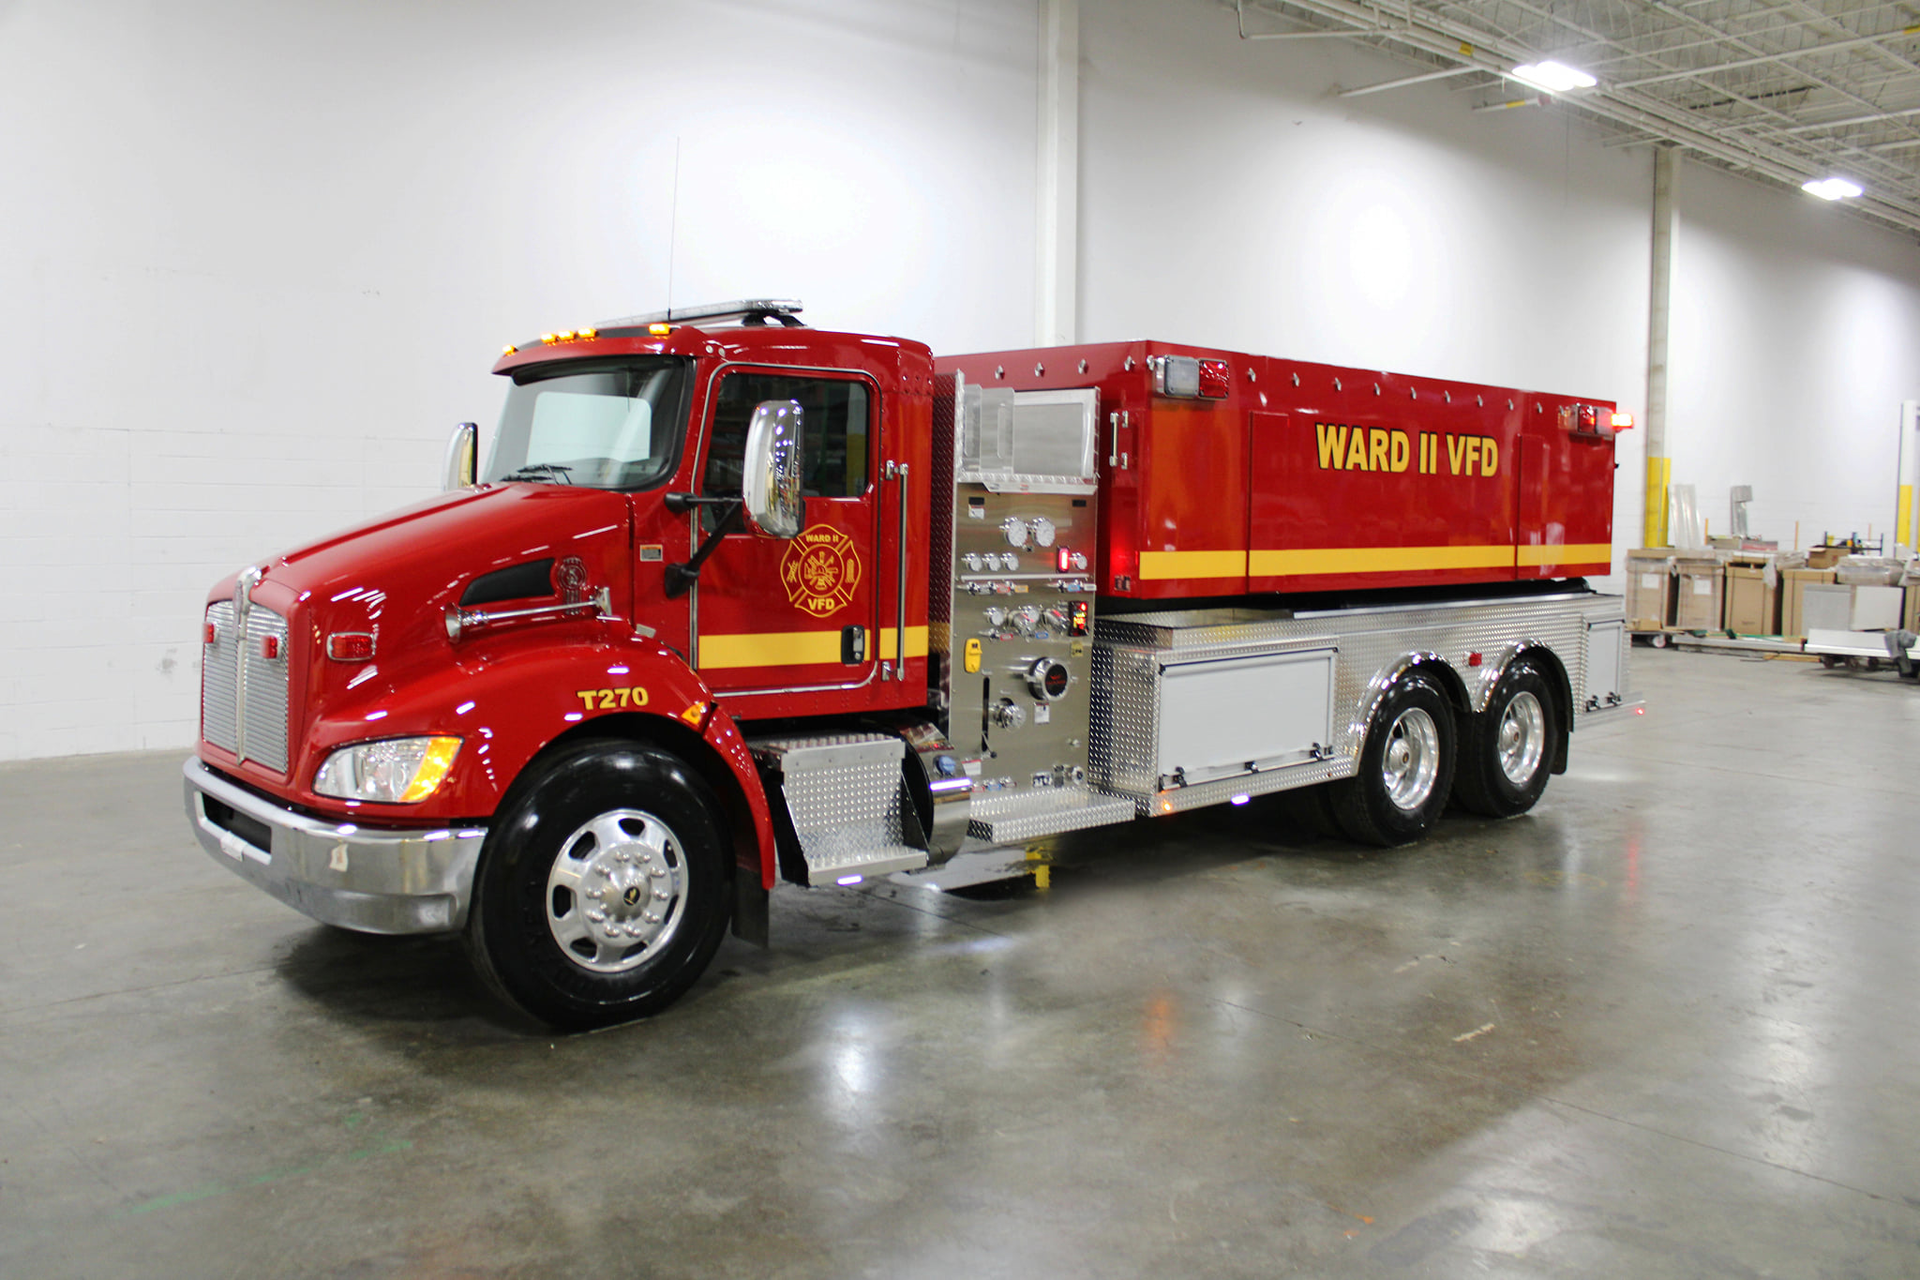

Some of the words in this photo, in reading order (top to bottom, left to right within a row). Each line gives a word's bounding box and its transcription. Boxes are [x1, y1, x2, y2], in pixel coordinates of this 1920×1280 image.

[1315, 422, 1410, 473] WARD
[1419, 431, 1438, 475] II
[1445, 432, 1499, 477] VFD
[805, 535, 831, 543] WARD
[807, 598, 835, 610] VFD
[576, 686, 649, 710] T270
